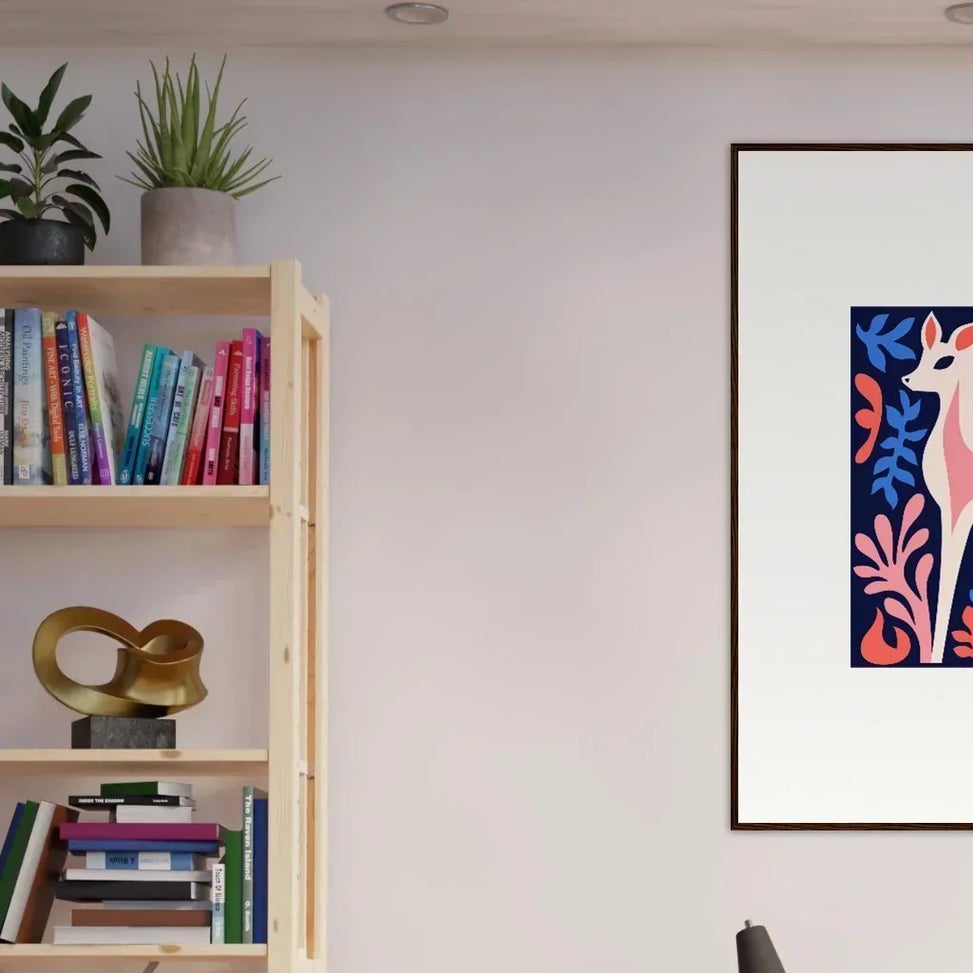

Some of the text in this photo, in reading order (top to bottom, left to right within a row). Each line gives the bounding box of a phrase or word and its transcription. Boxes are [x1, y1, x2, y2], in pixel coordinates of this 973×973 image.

[18, 325, 33, 386] Oil Paintings
[47, 347, 56, 364] FINE
[48, 365, 57, 379] ART
[59, 344, 74, 408] ICONIC
[80, 327, 98, 411] Watercolor Portraits
[49, 402, 60, 425] Digital
[229, 363, 241, 416] Parenting Skills
[53, 426, 62, 442] Tools
[141, 397, 158, 447] SUCCESSFUL
[244, 795, 252, 880] The Raven Island
